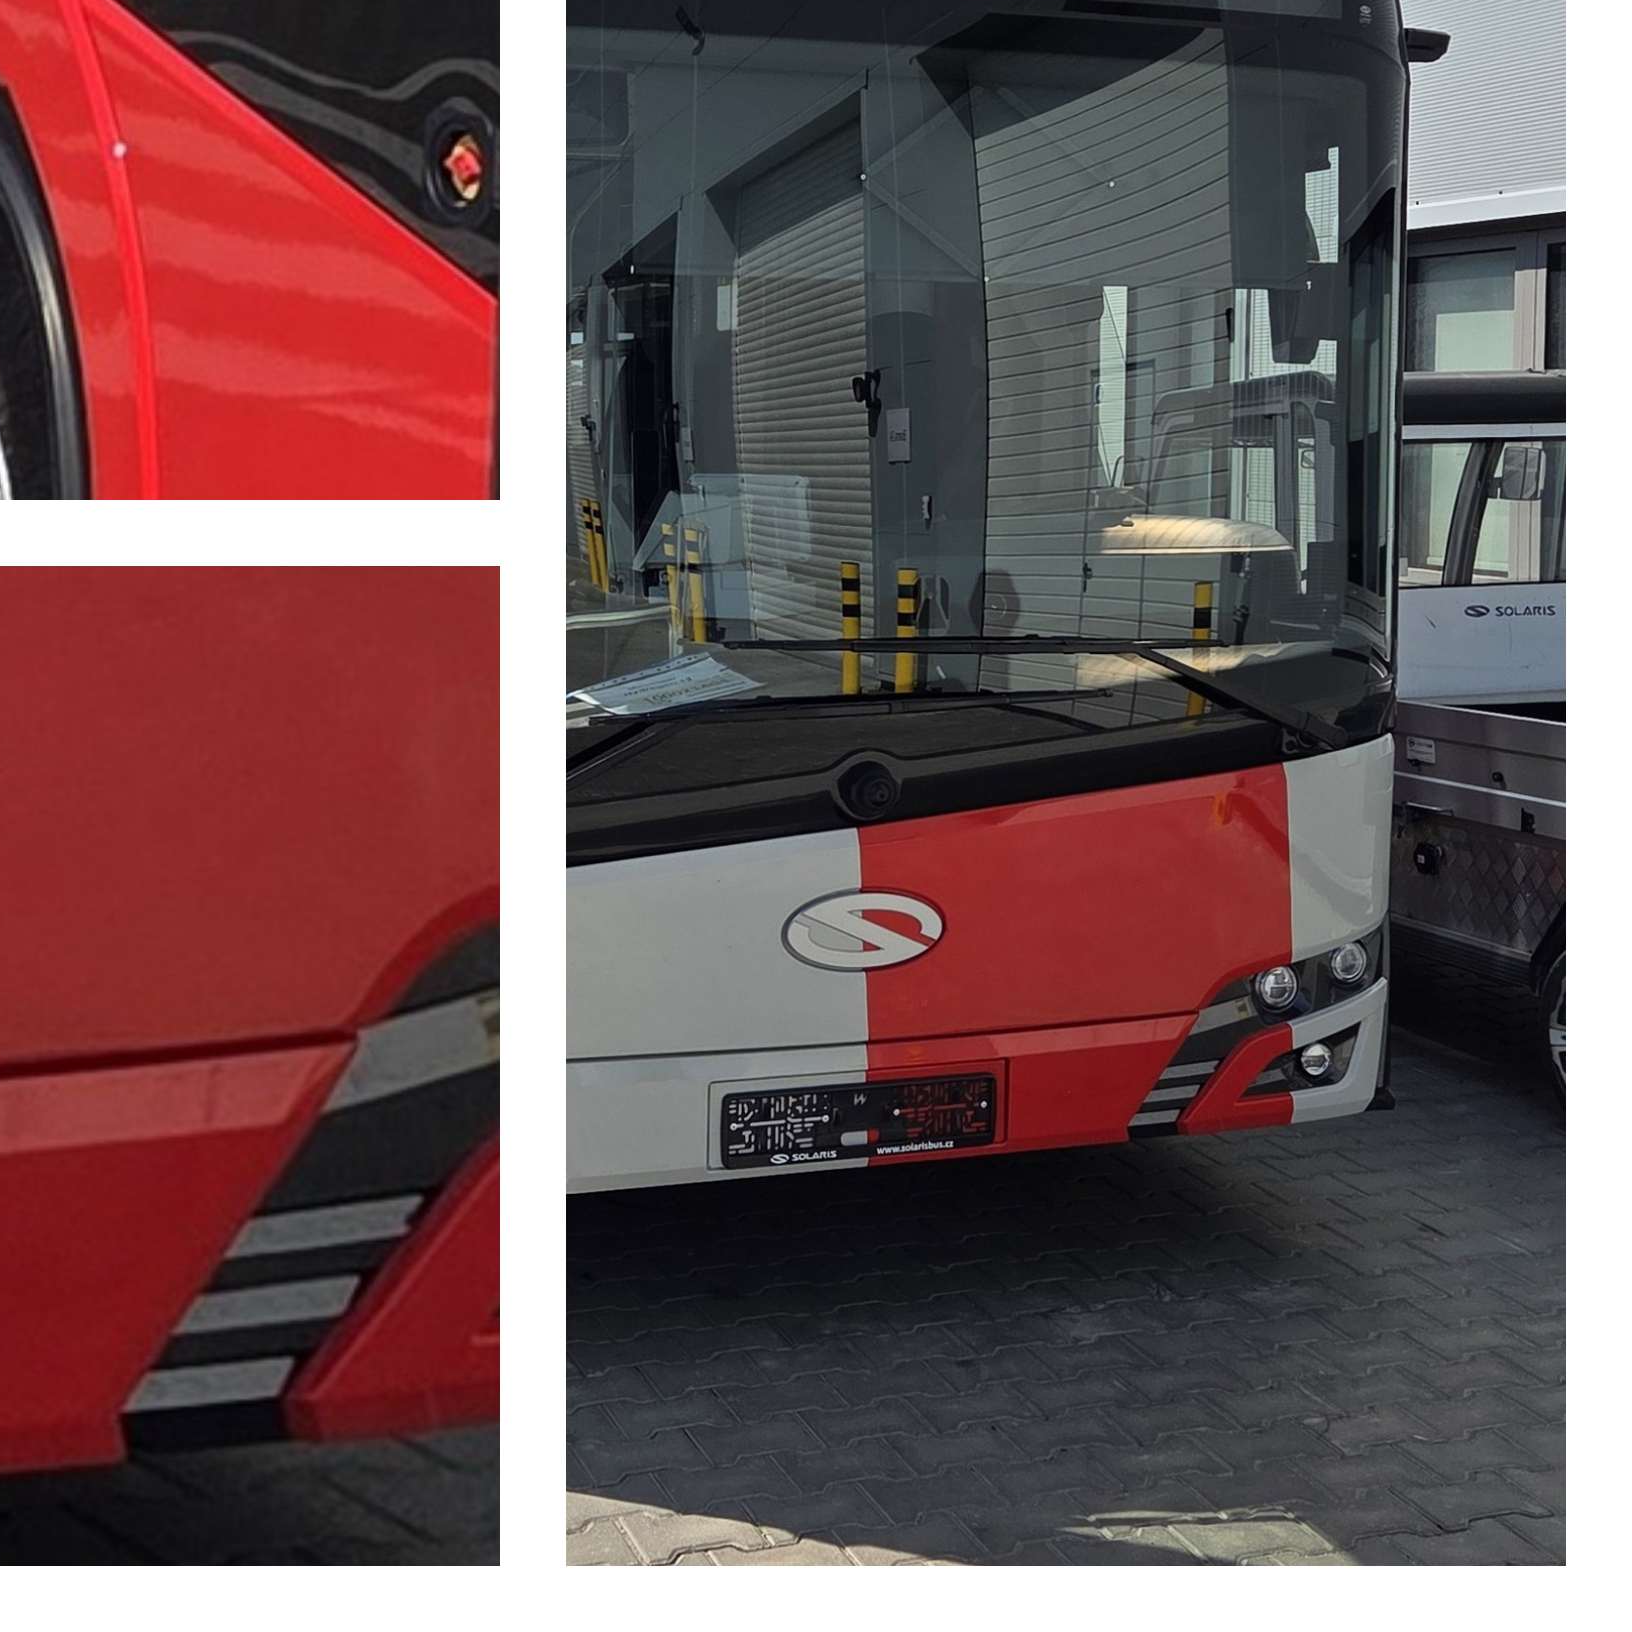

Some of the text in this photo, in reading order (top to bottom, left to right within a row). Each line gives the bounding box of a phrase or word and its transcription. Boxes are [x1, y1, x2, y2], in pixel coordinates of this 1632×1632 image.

[1495, 605, 1556, 617] SOLARIS
[876, 1140, 954, 1155] www.solarisbus.cz
[791, 1150, 838, 1163] SOLARIS
